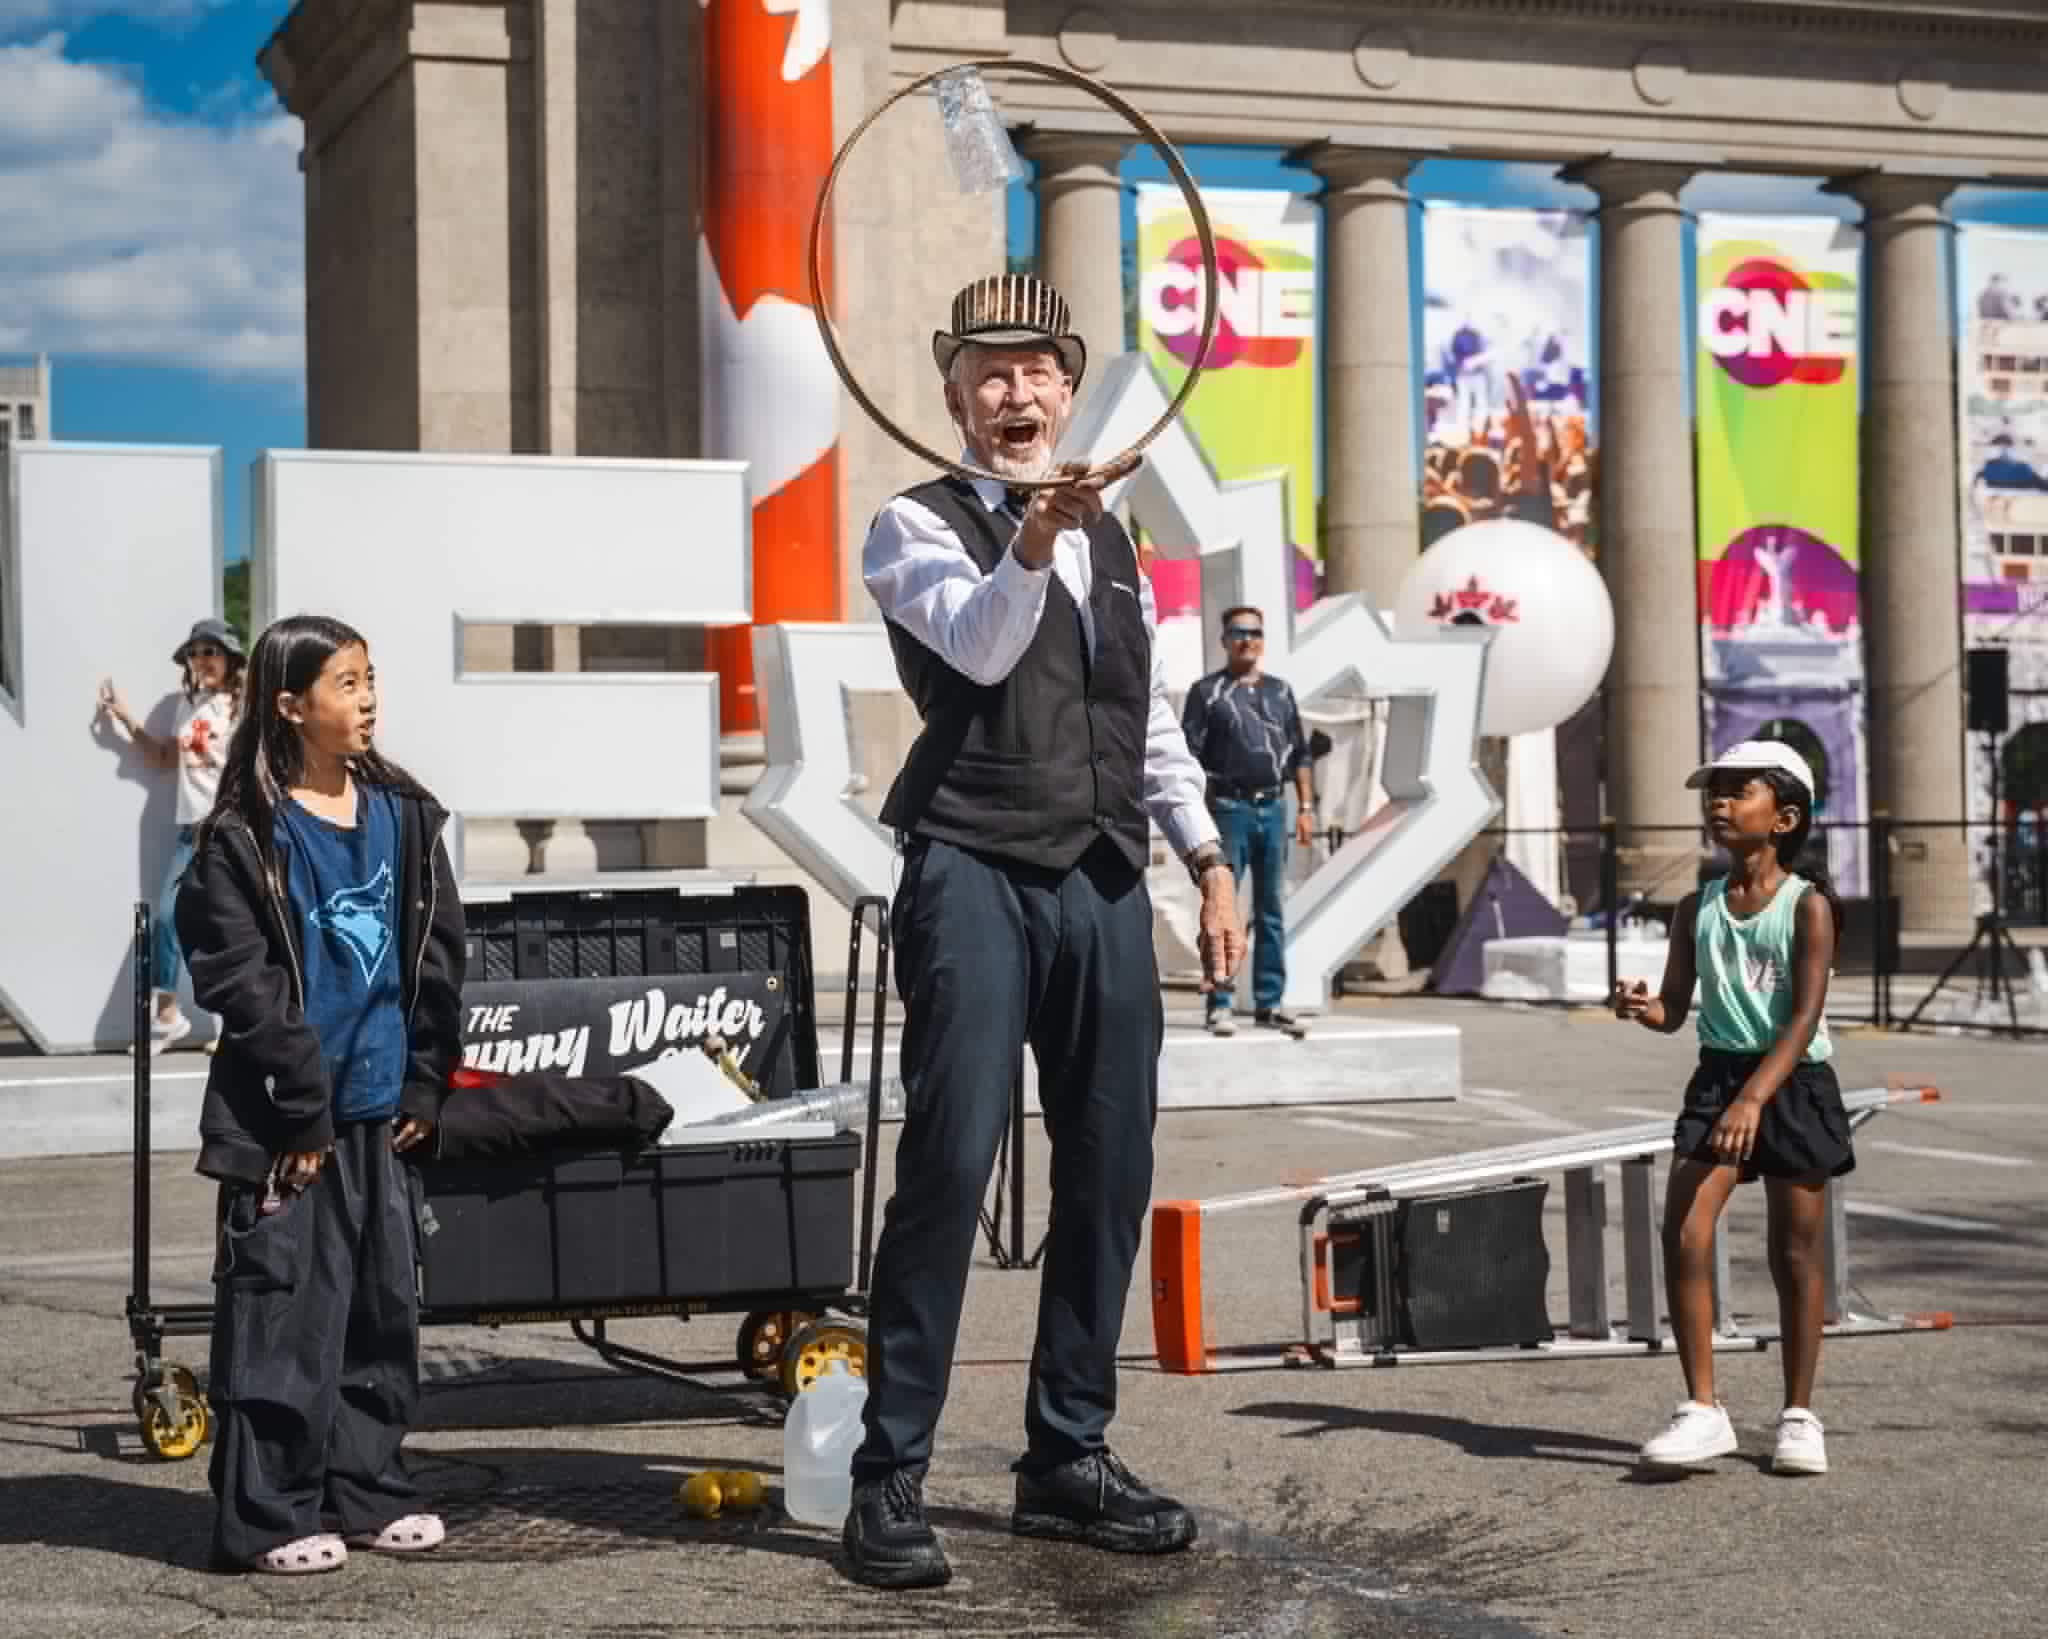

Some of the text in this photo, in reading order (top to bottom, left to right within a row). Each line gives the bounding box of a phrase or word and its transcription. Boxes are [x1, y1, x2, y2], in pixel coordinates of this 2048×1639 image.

[1138, 263, 1312, 338] CNE
[1699, 285, 1857, 359] CNE
[463, 1025, 591, 1079] unny
[608, 987, 767, 1057] Waiter
[466, 1004, 520, 1033] THE
